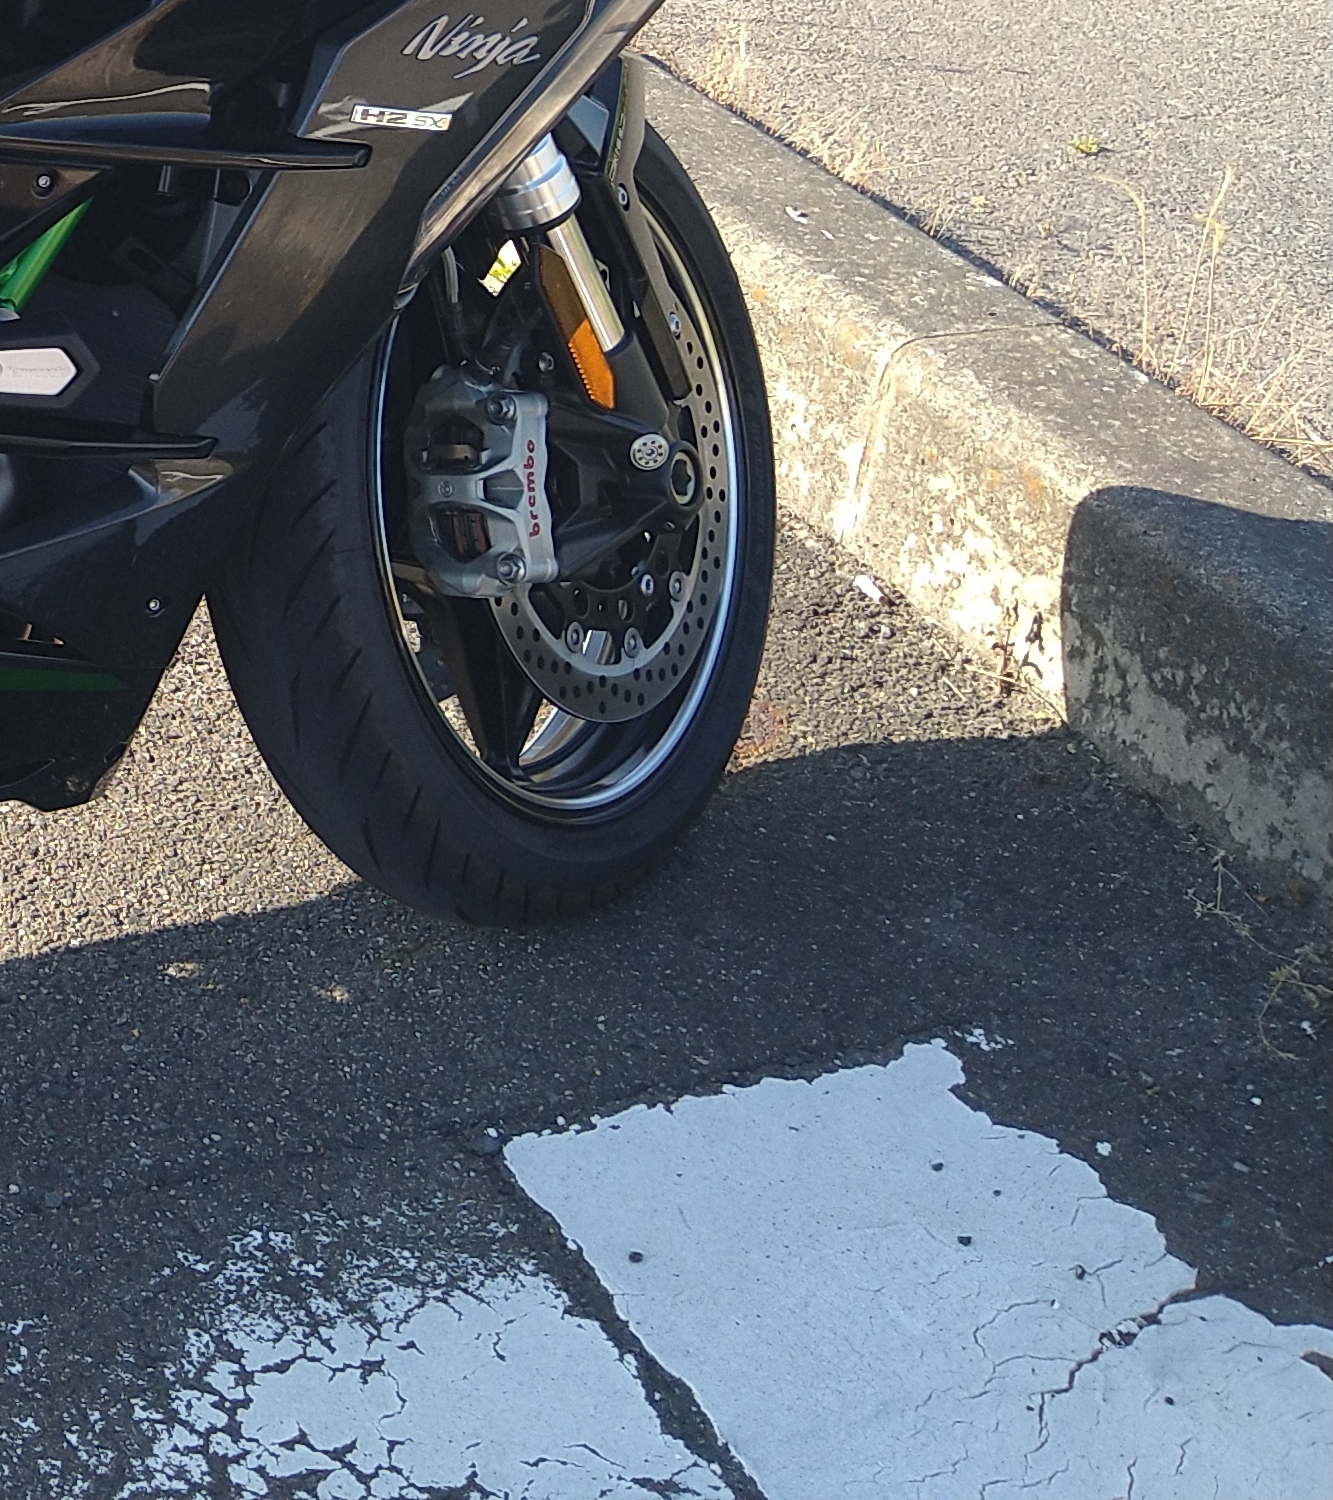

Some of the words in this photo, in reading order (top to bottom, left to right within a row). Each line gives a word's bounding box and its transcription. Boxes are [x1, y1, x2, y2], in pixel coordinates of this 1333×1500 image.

[401, 13, 541, 79] Ninja
[360, 108, 408, 125] H2
[411, 115, 449, 129] SX
[523, 439, 540, 537] brembo
